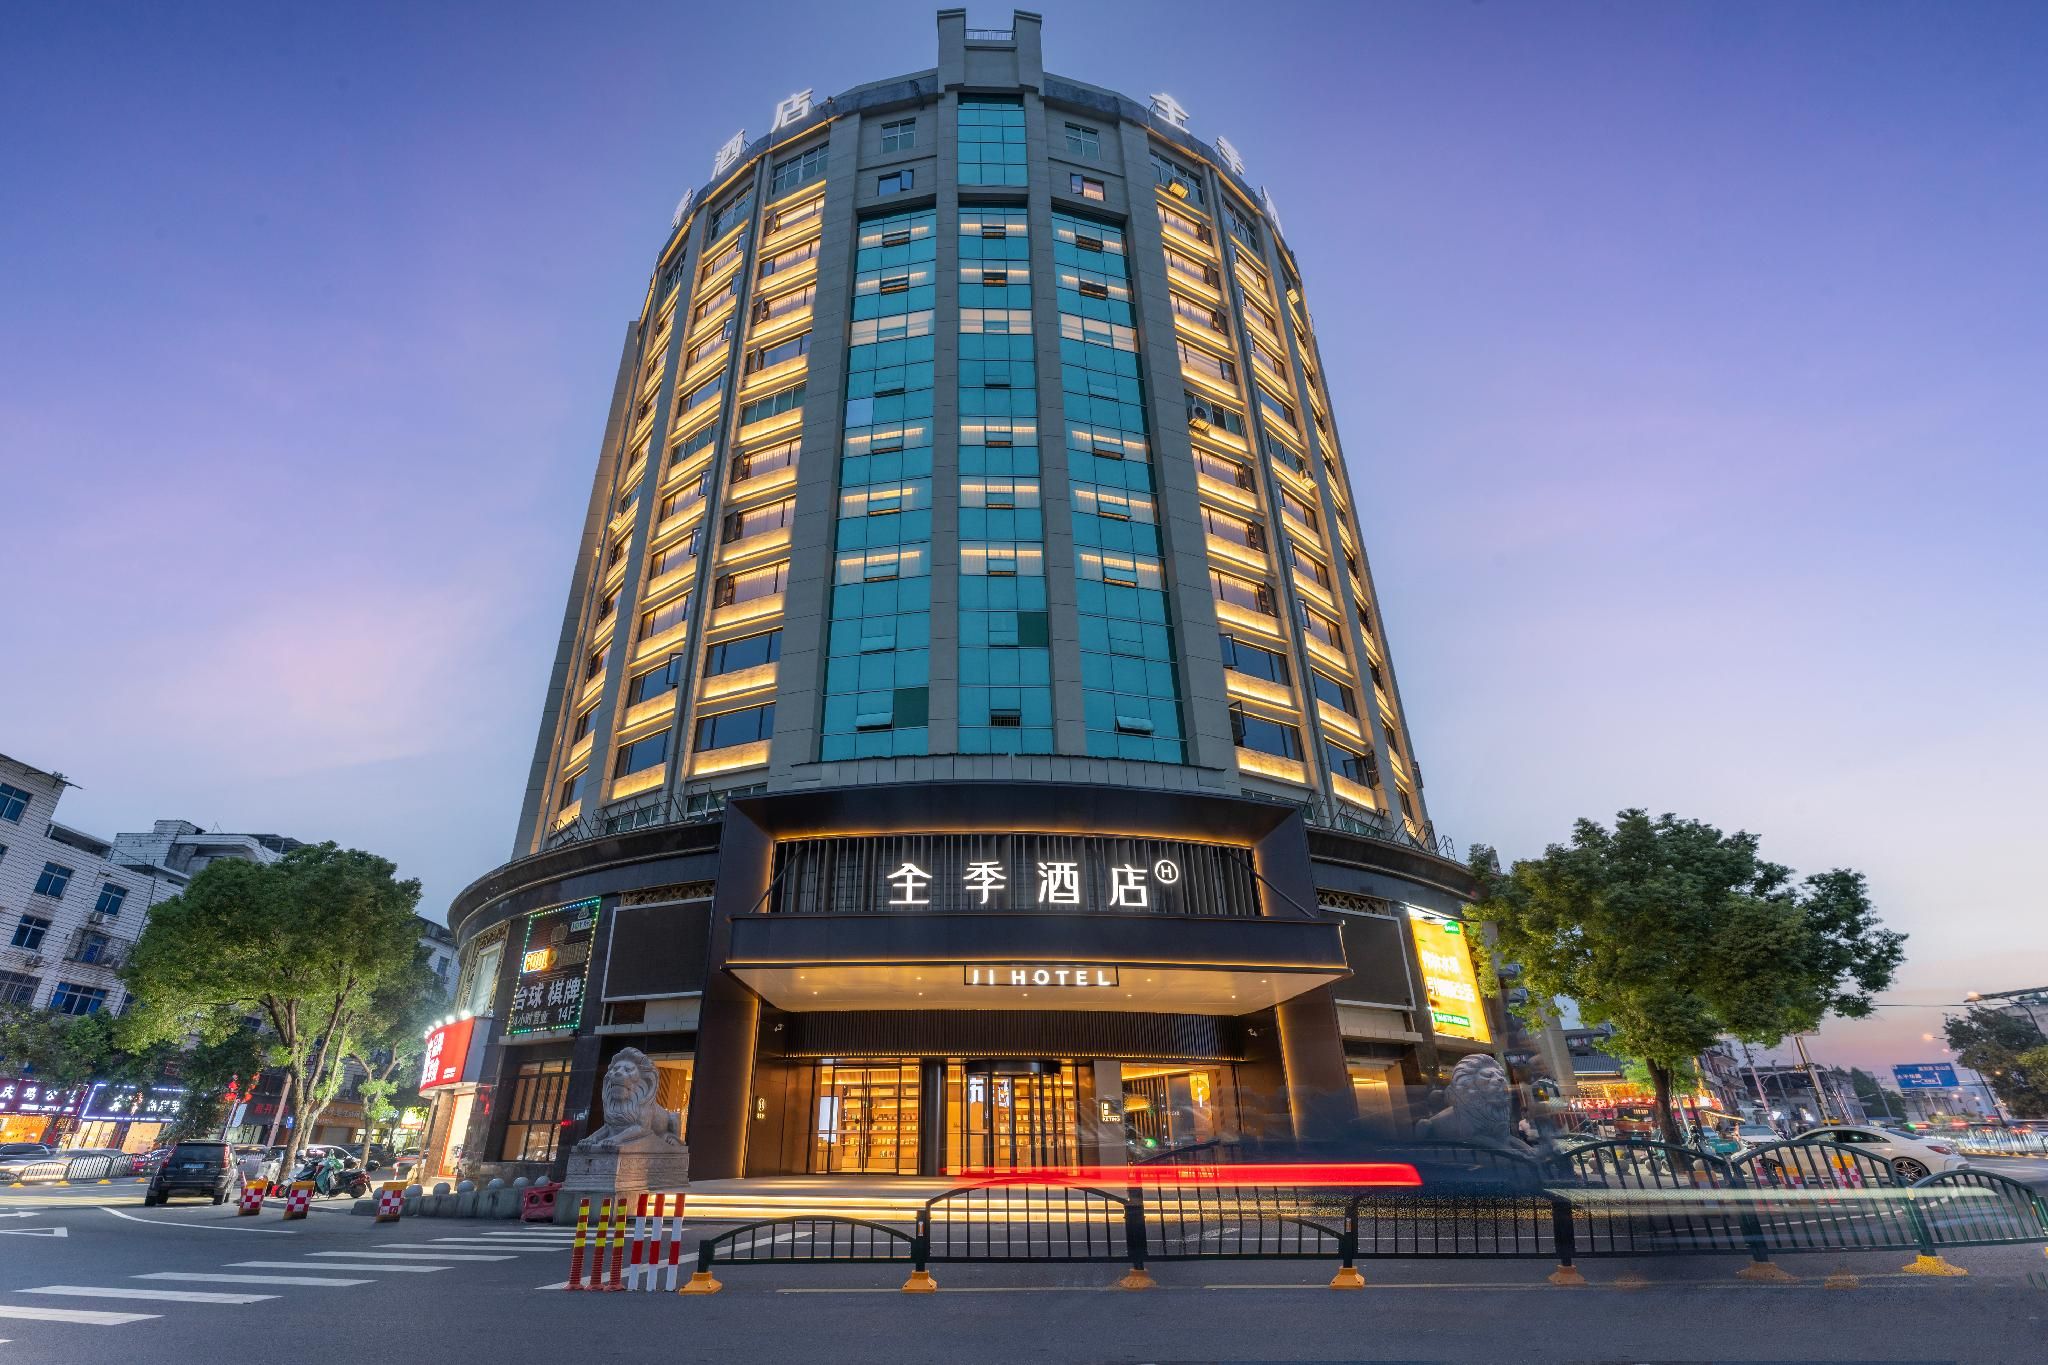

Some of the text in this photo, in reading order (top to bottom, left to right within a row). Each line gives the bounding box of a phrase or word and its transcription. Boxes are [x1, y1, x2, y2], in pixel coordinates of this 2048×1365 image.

[887, 861, 1148, 907] 全季酒店
[973, 969, 1111, 986] JI HOTEL
[515, 977, 581, 1010] 台球 棋牌
[558, 1005, 576, 1022] 14F
